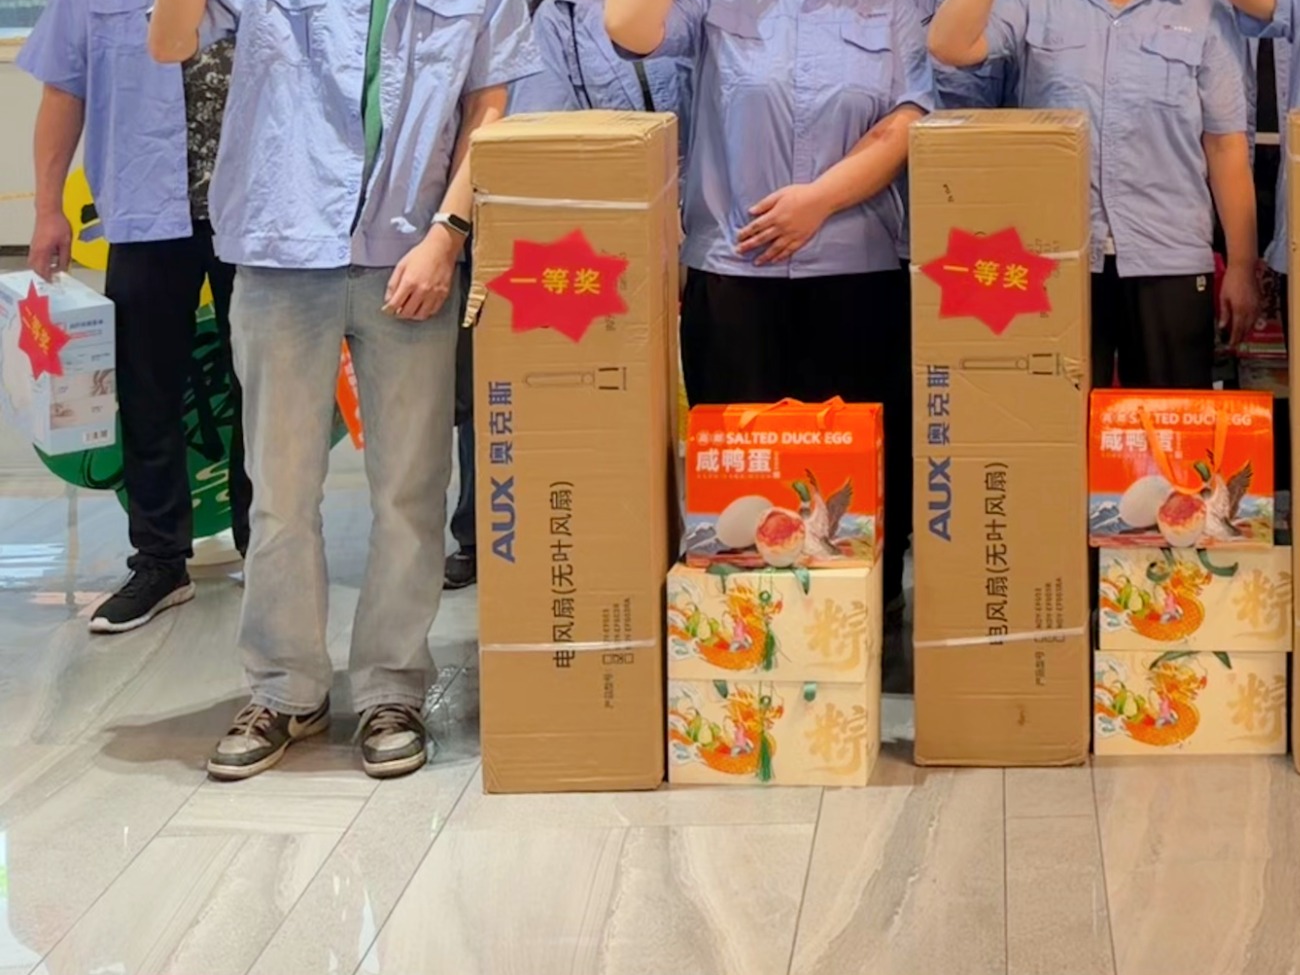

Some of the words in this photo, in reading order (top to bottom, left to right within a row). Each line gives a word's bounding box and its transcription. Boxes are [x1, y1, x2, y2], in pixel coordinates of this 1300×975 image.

[510, 267, 601, 295] 一等奖
[943, 259, 1030, 291] 一等奖
[488, 381, 513, 465] 奥克斯
[726, 432, 778, 444] SALTED
[782, 432, 821, 444] DUCK
[824, 432, 853, 444] EGG
[926, 364, 950, 445] 奥克斯
[1183, 412, 1221, 425] DUC
[696, 448, 771, 473] 咸鸭蛋
[928, 457, 951, 541] AUX
[490, 476, 516, 563] AUX
[984, 462, 1008, 646] 电风扇(无叶风扇)
[549, 481, 576, 669] 电风扇(无叶风扇)
